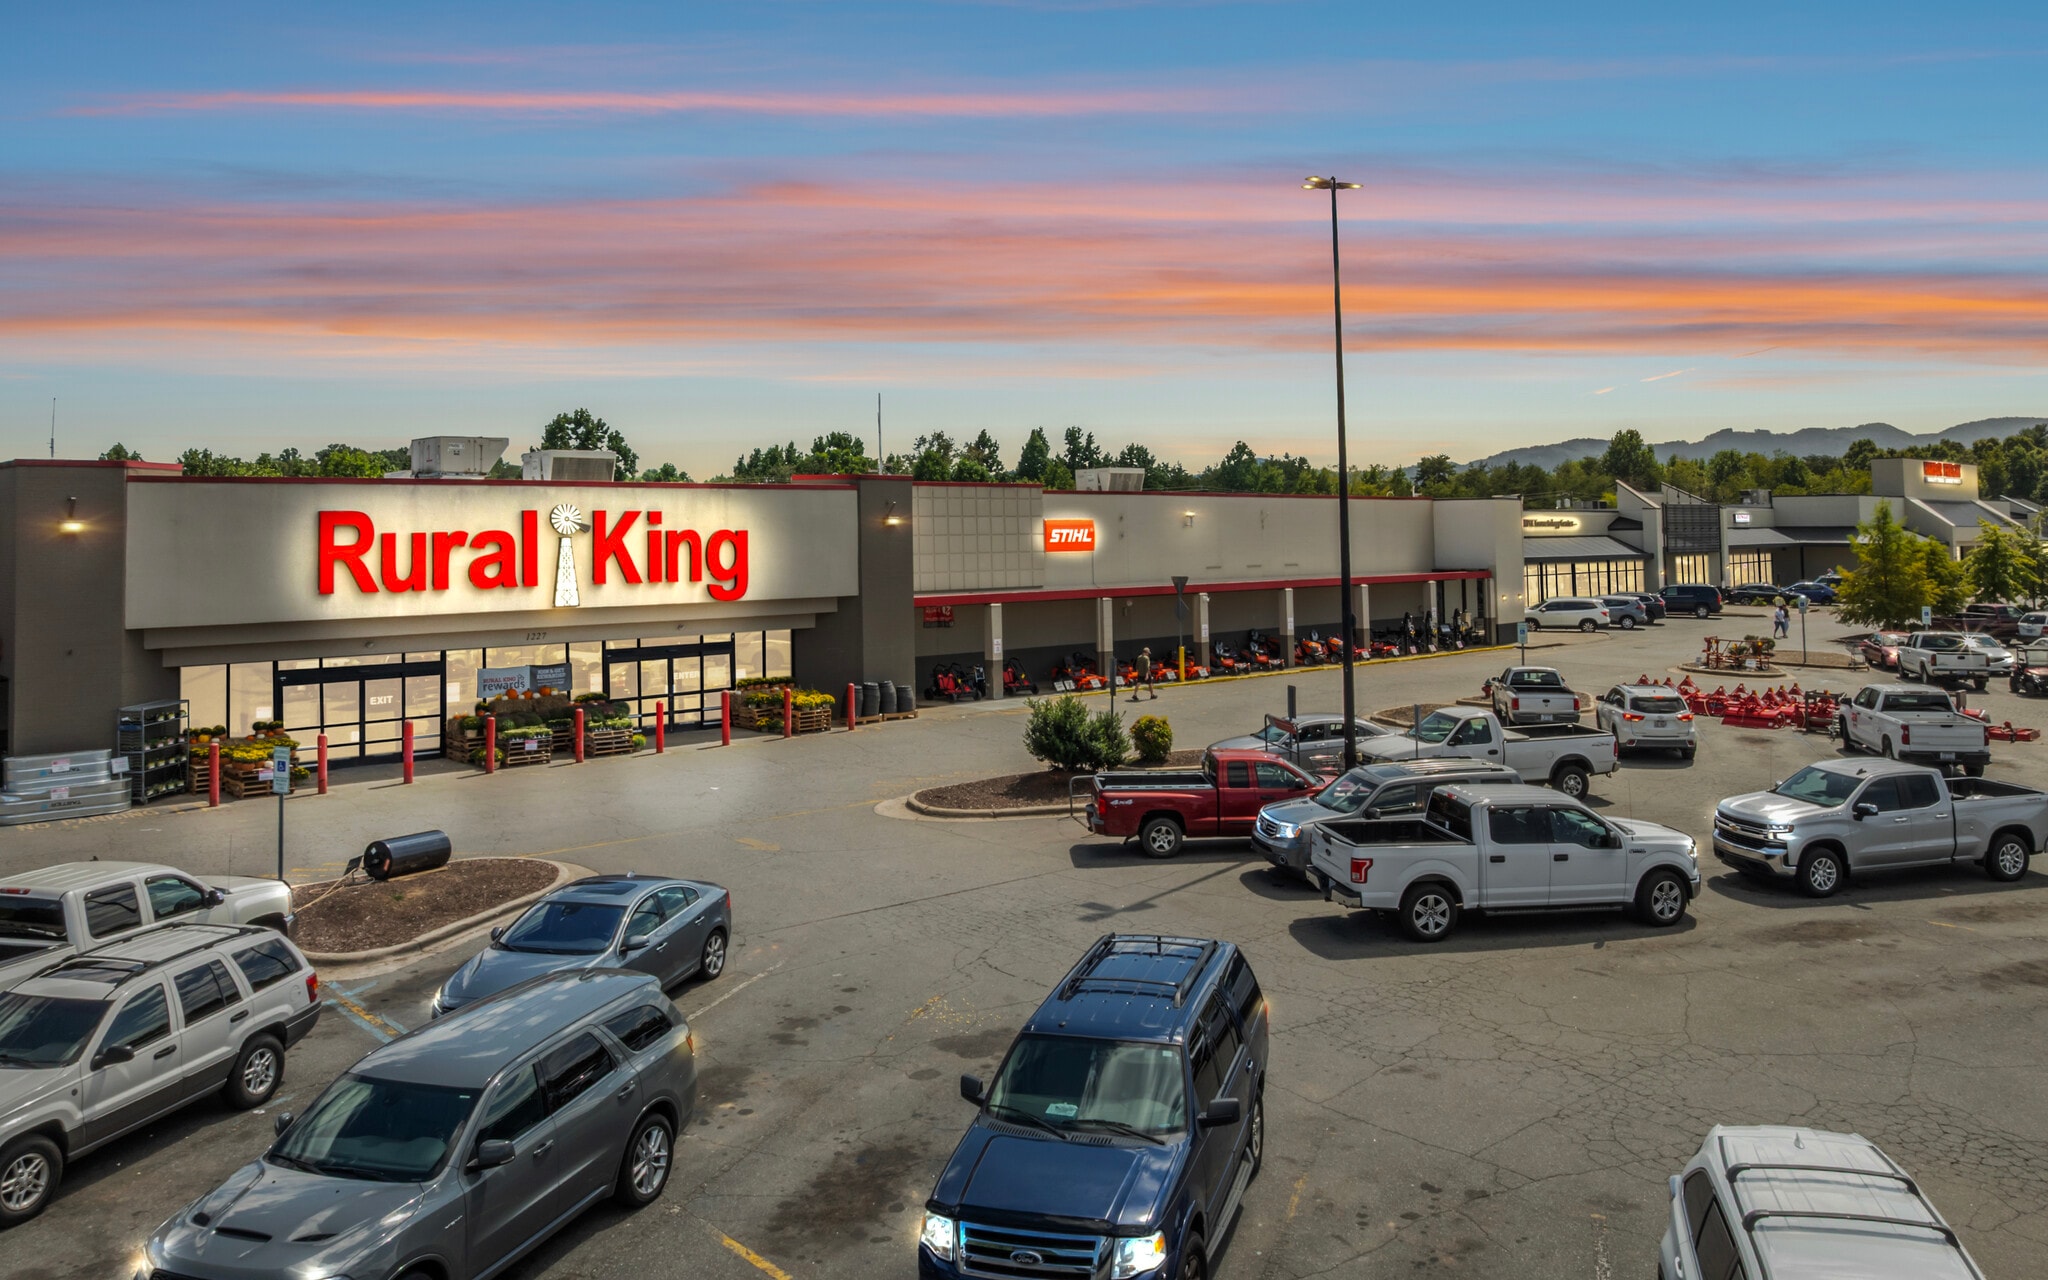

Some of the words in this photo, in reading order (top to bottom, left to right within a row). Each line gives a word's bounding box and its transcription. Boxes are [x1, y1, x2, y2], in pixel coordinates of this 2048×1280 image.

[1050, 528, 1092, 543] STIHL
[318, 510, 538, 594] Rural
[592, 510, 749, 600] King
[526, 631, 547, 641] 1227
[673, 670, 700, 680] ENTER
[483, 679, 525, 691] rewards
[370, 695, 393, 705] EXIT
[15, 822, 50, 832] NO
[61, 809, 160, 826] PARKING
